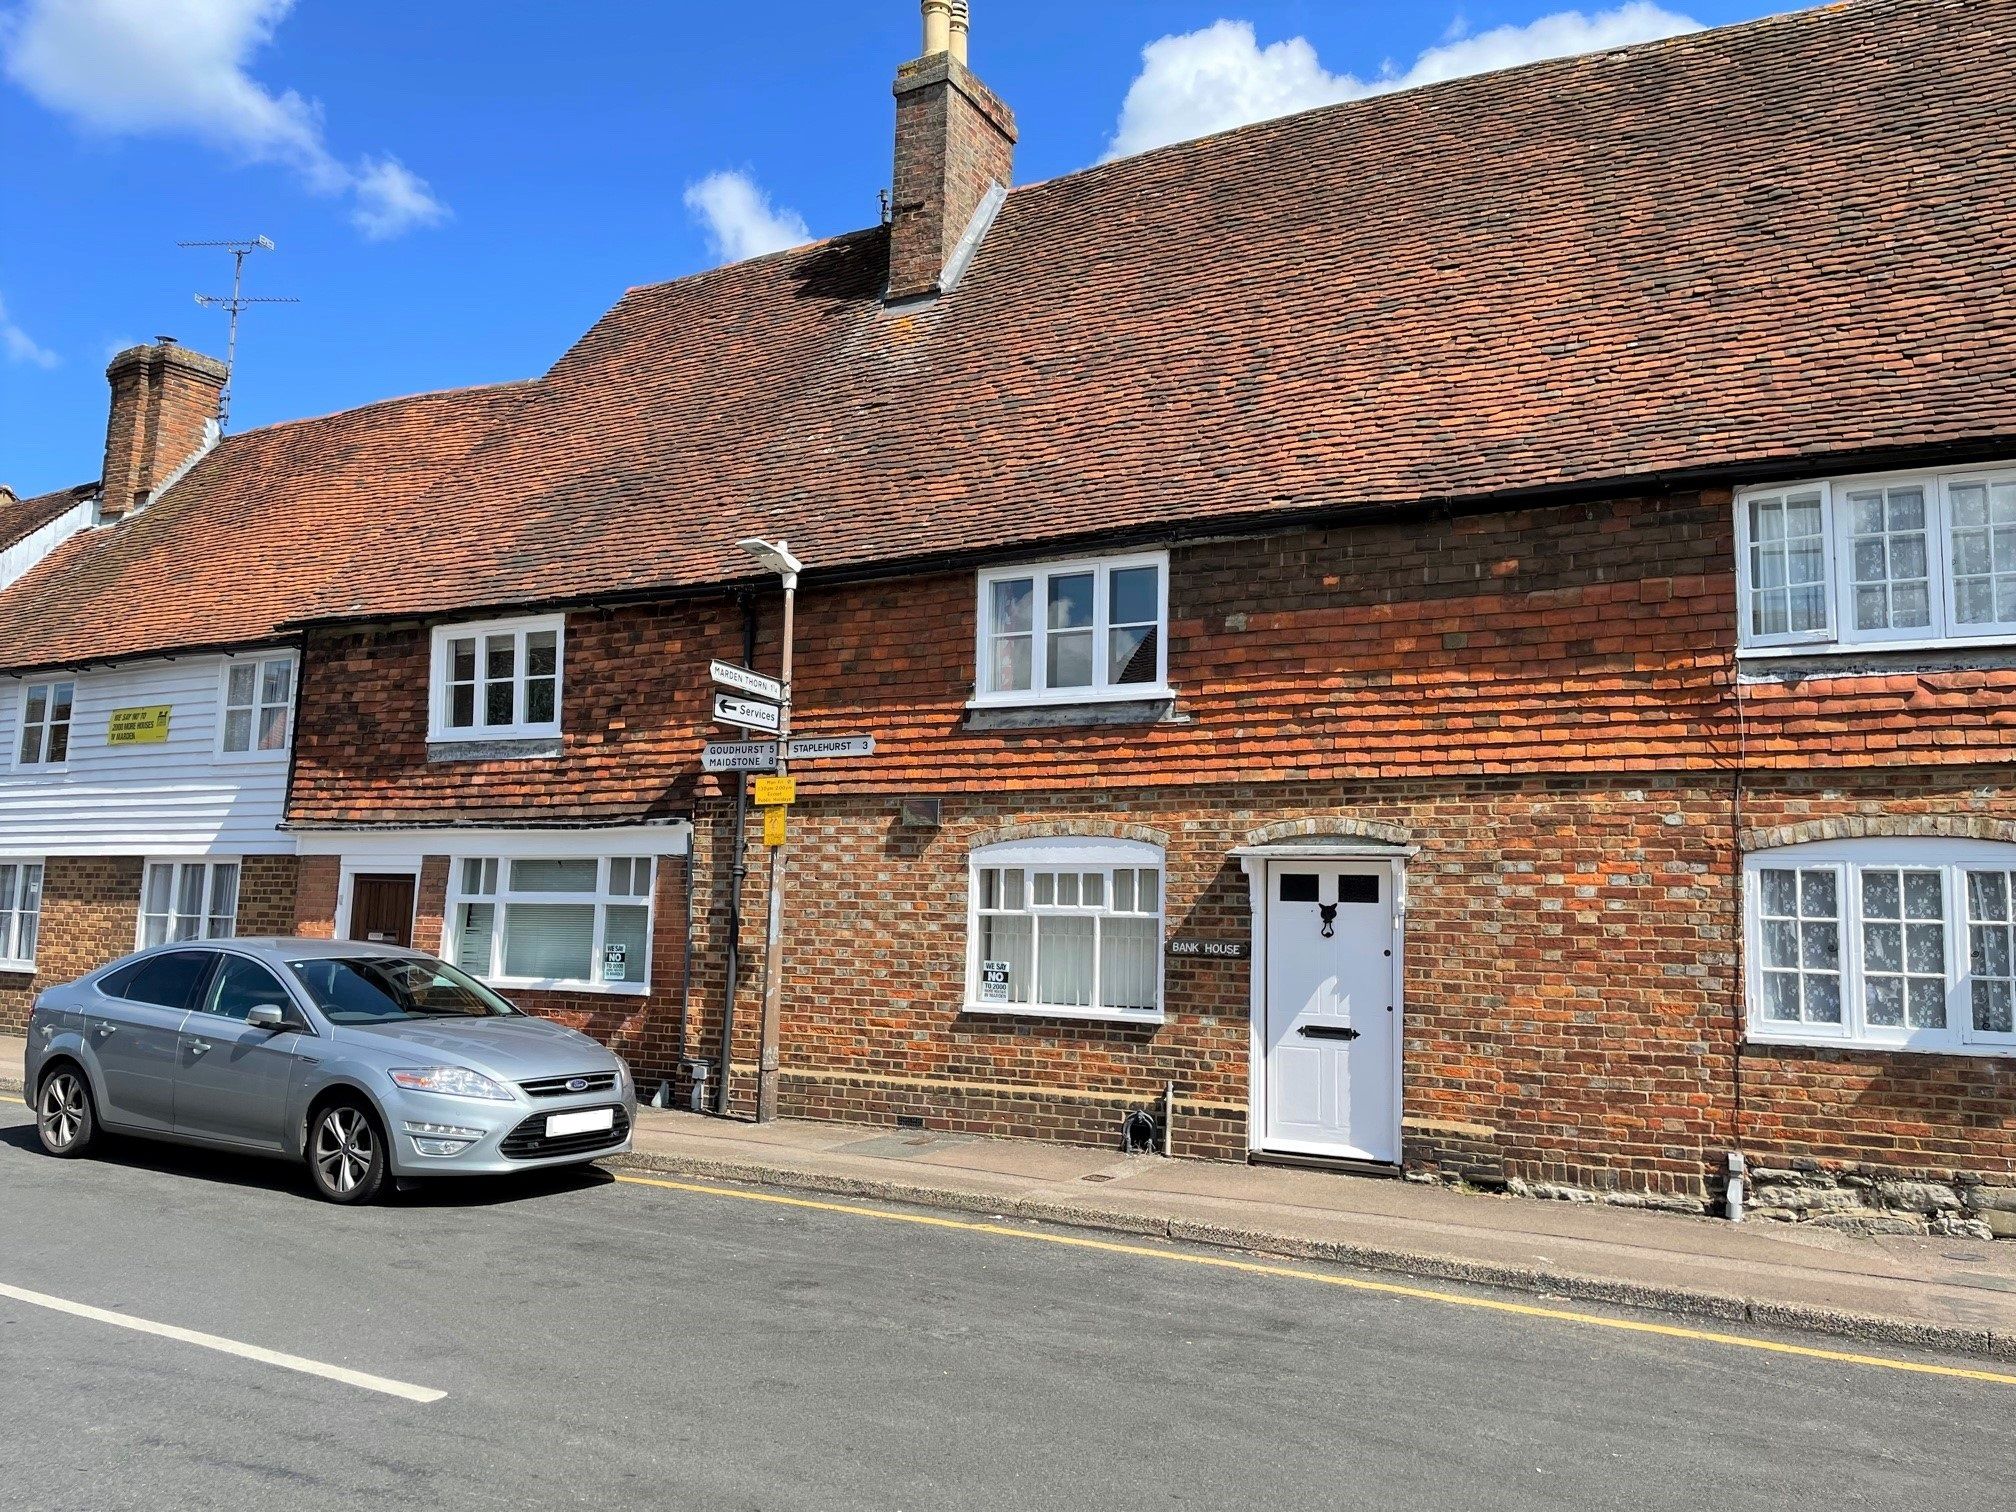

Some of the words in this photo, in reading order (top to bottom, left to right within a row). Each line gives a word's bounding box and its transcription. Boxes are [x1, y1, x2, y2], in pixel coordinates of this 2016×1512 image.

[714, 666, 743, 683] MARDEN
[745, 676, 768, 690] THORN
[740, 704, 775, 722] Services
[124, 722, 136, 730] MORE
[137, 720, 154, 730] HOUSES
[116, 732, 136, 741] MARDEN
[709, 745, 765, 755] GOUDHURST
[769, 745, 775, 754] 5
[793, 741, 852, 753] STAPLEHURST
[862, 741, 869, 750] 3
[709, 757, 760, 767] MAIDSTONE
[768, 756, 774, 765] 8
[1172, 942, 1199, 953] BANK
[1204, 943, 1240, 955] HOUSE
[608, 953, 622, 962] NO
[985, 962, 995, 970] WE
[996, 963, 1007, 971] SAY
[987, 971, 1004, 982] NO
[992, 983, 1007, 991] 2000
